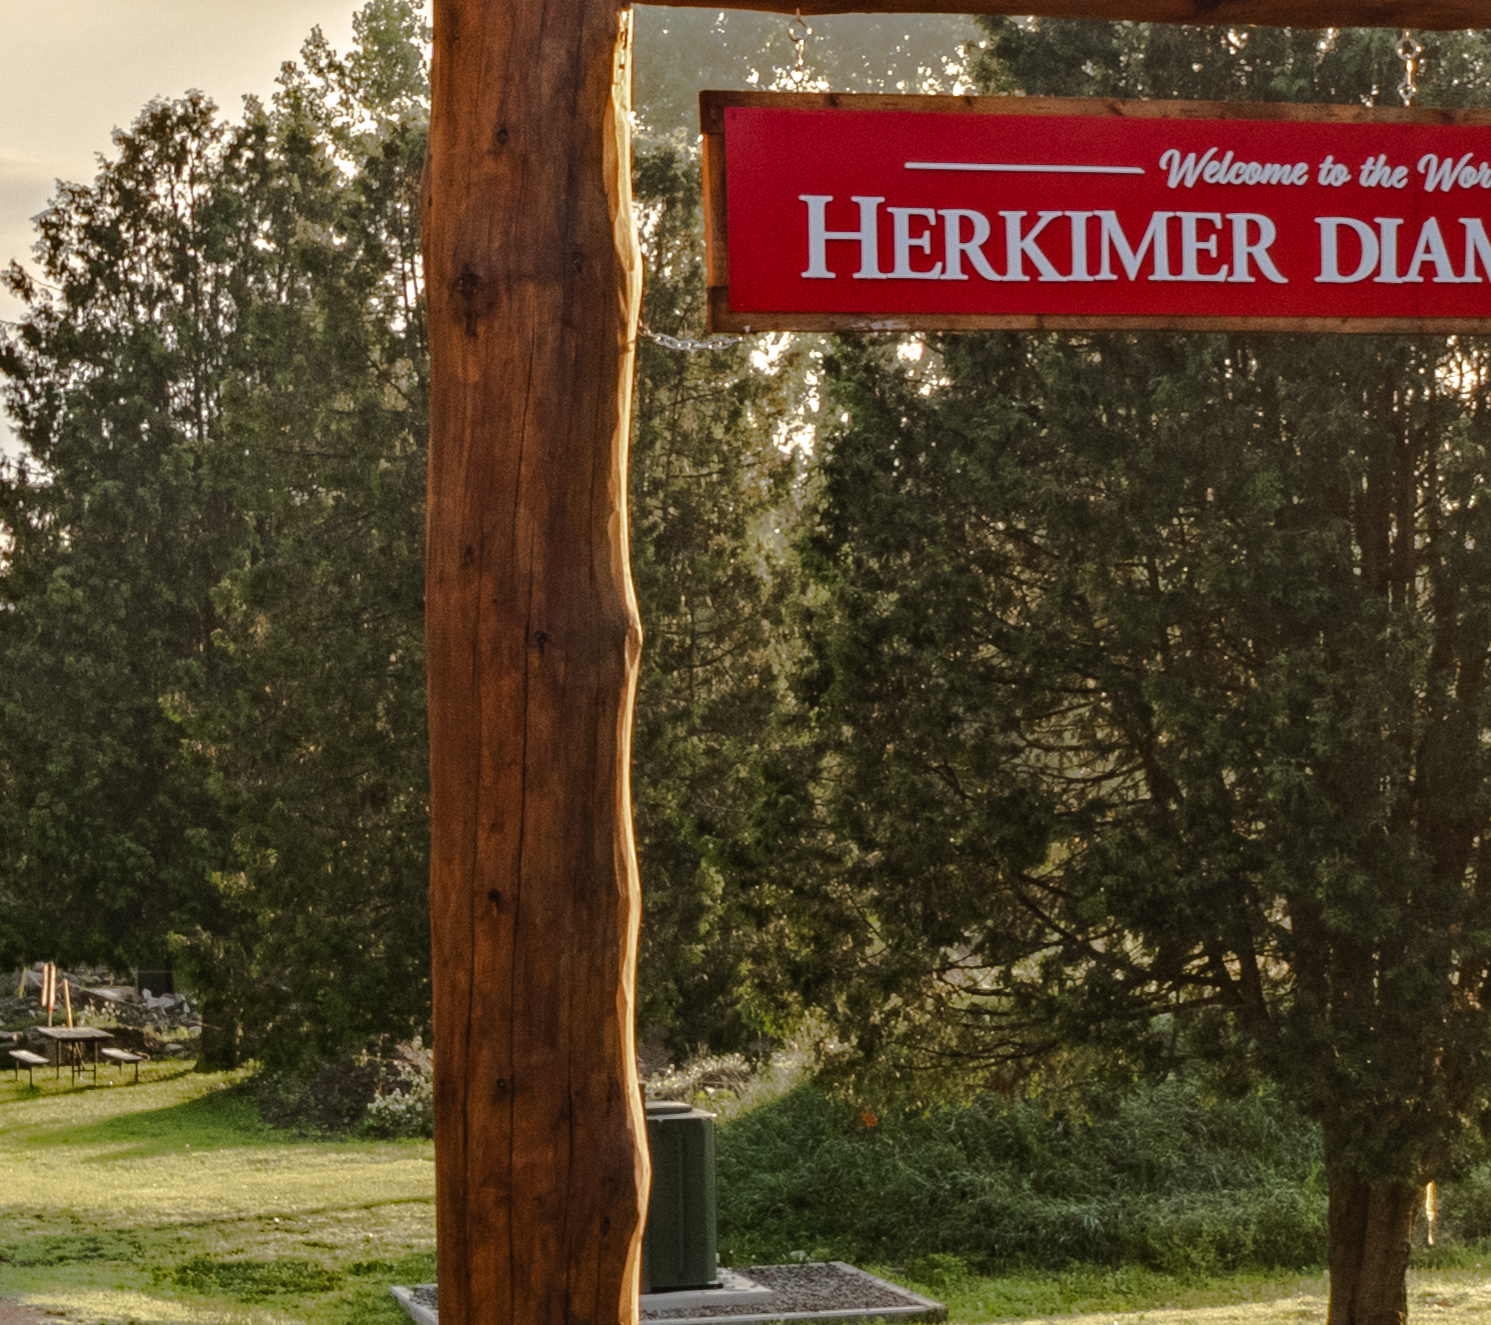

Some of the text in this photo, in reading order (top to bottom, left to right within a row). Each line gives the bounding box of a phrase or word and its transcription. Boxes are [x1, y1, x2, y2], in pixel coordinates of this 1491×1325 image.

[1159, 148, 1309, 189] Welcome
[1317, 154, 1352, 187] to
[1359, 153, 1409, 189] the
[799, 194, 1288, 284] HERKIMER
